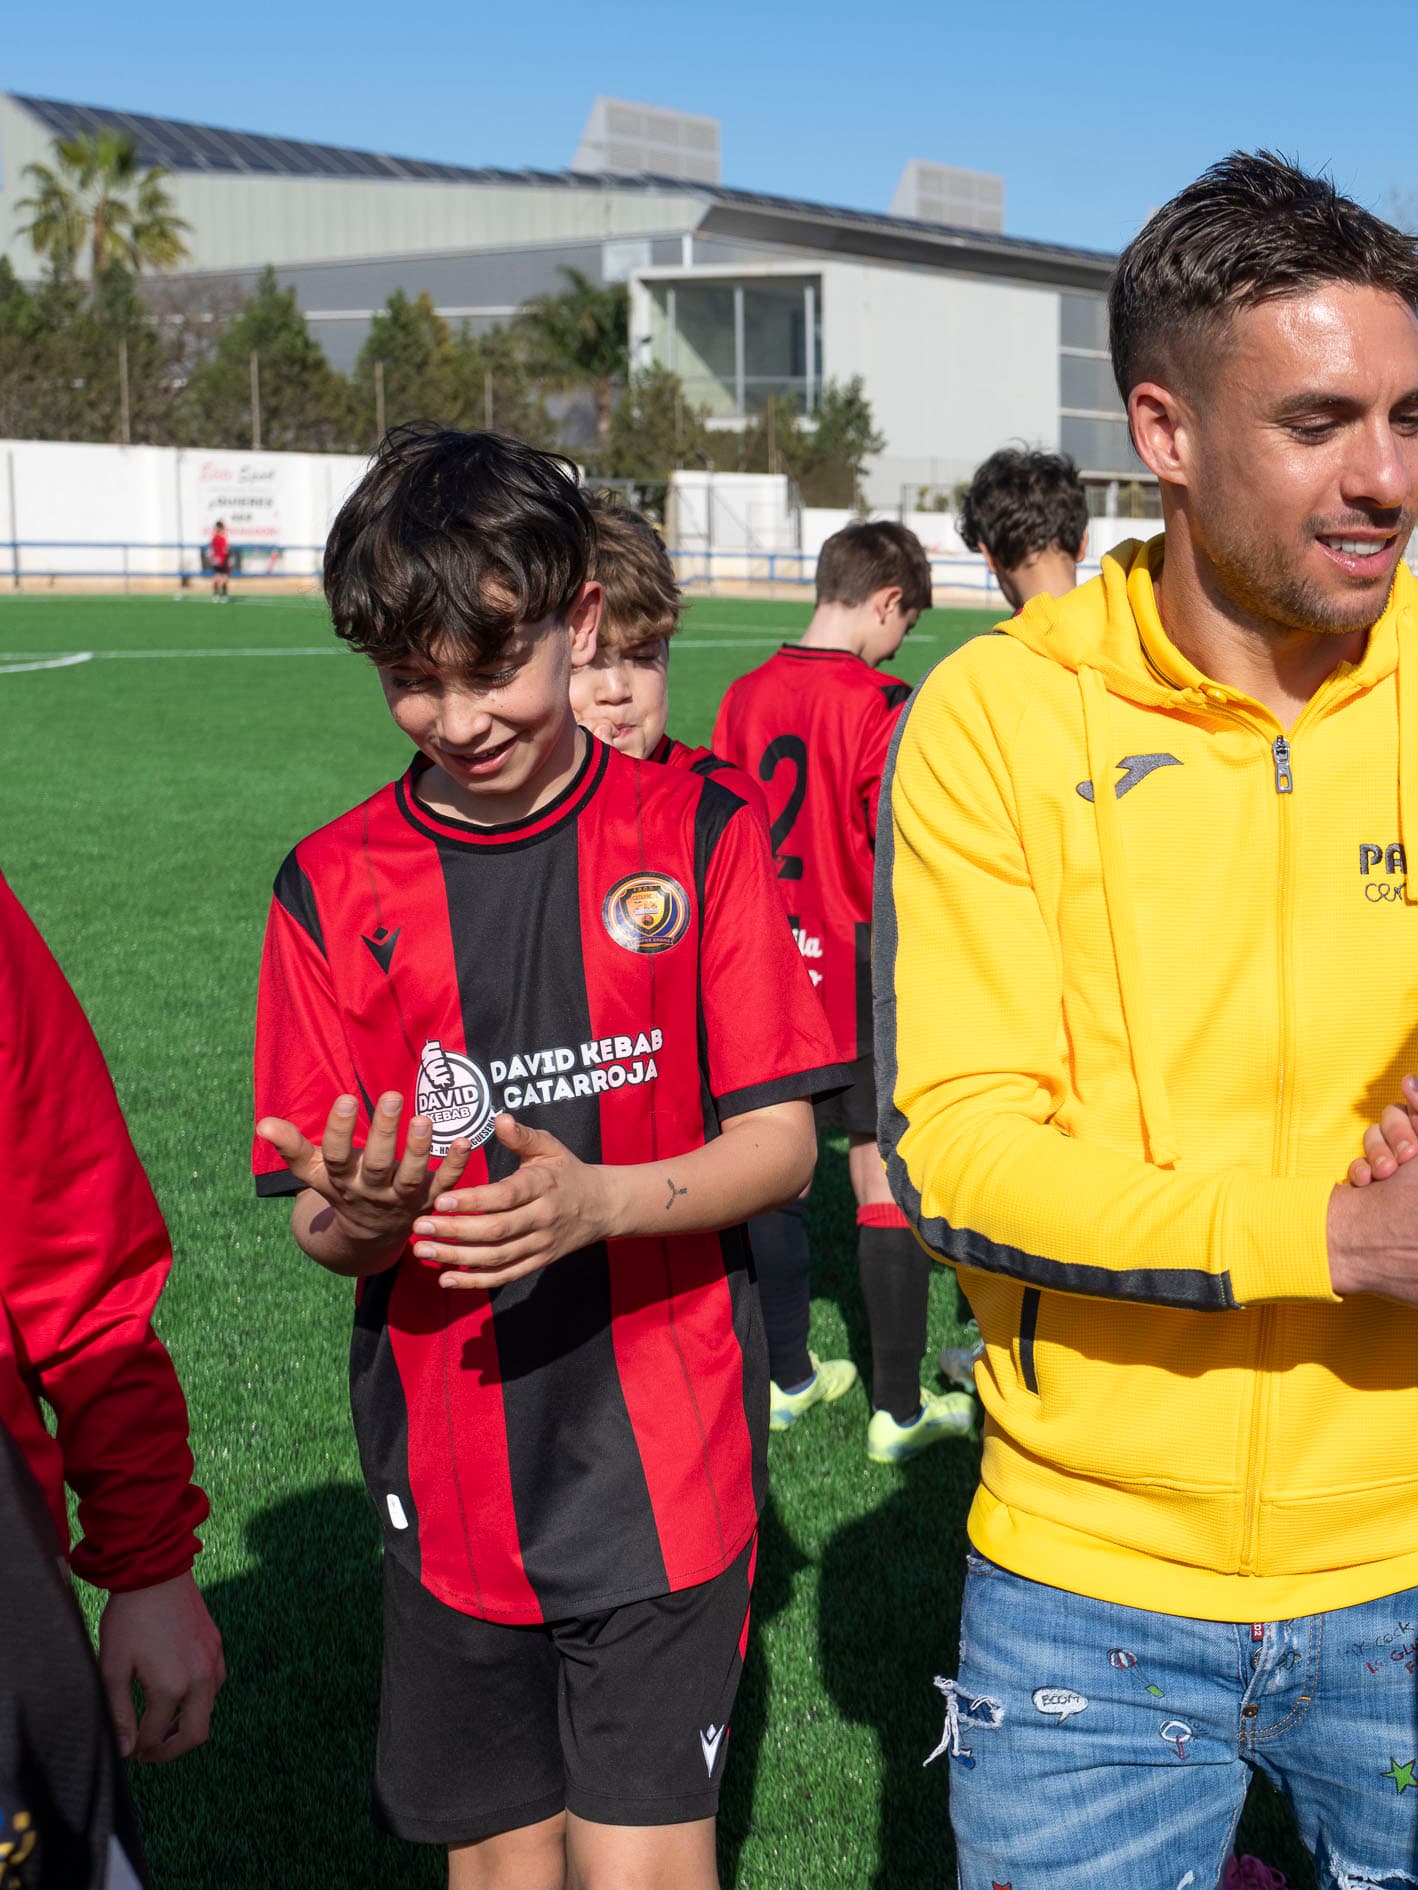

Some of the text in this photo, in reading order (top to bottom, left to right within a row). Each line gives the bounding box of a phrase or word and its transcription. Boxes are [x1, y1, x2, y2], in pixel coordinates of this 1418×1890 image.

[490, 1028, 664, 1085] DAVID KEBAB
[418, 1086, 480, 1112] DAVID
[503, 1059, 659, 1110] CATARROJA
